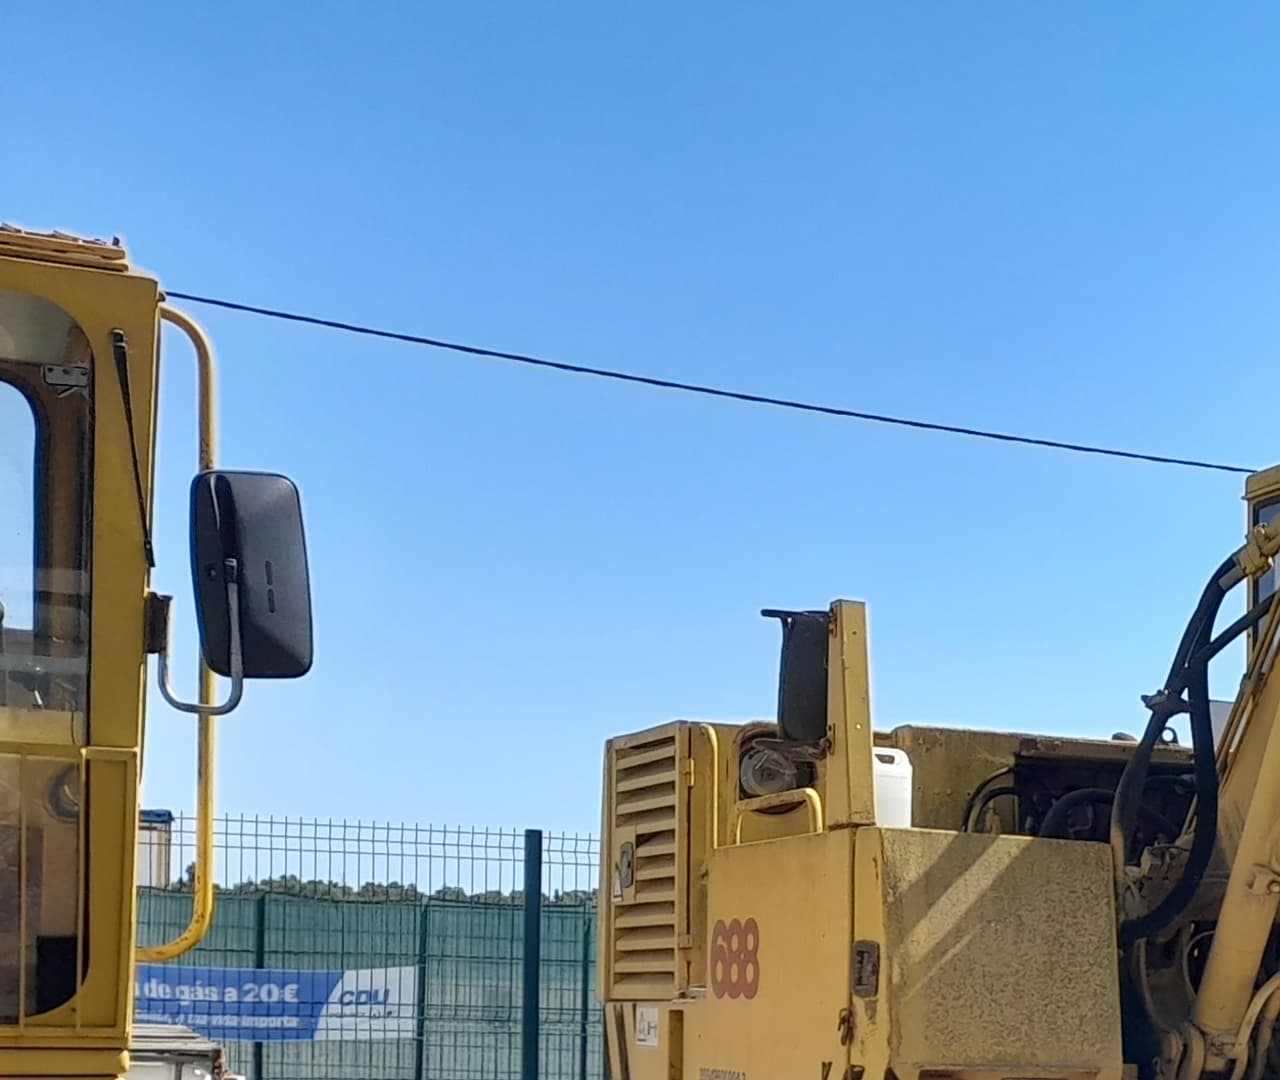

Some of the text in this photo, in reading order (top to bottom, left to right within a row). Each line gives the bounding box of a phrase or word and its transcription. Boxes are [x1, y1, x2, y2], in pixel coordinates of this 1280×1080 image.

[711, 917, 760, 1000] 688
[144, 978, 171, 999] de
[176, 980, 219, 1005] gás
[224, 987, 238, 1002] a
[241, 983, 299, 1003] 20€
[340, 988, 391, 1006] CDU
[242, 1015, 299, 1028] importa
